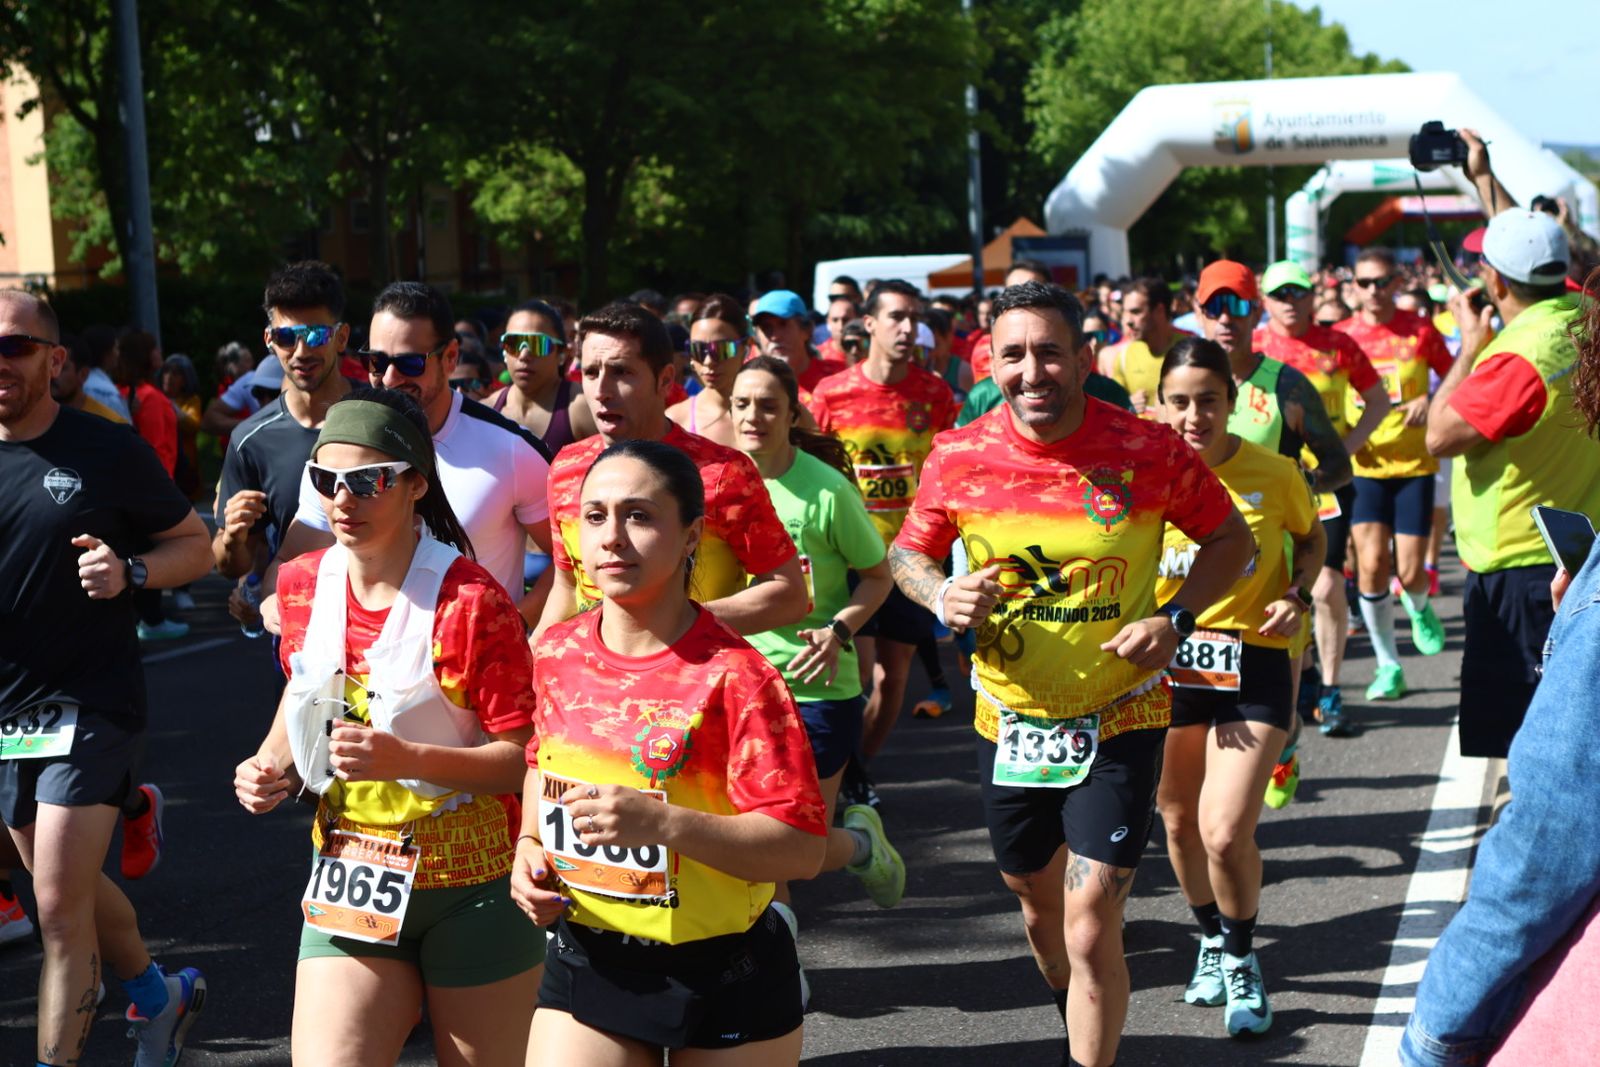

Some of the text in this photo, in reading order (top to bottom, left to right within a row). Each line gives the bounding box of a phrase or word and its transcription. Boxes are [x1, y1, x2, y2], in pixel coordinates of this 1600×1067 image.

[1265, 112, 1387, 132] Ayuntamiento
[1265, 133, 1388, 150] de Salamanca
[866, 478, 908, 499] 209
[1023, 605, 1089, 623] FERNANDO
[1091, 602, 1120, 621] 2026
[1176, 641, 1233, 671] 881
[1004, 729, 1093, 764] 1339
[437, 843, 445, 857] EL
[451, 837, 486, 857] TRABAJO
[422, 856, 448, 870] VALOR
[452, 853, 468, 868] POR
[312, 858, 406, 914] 1965
